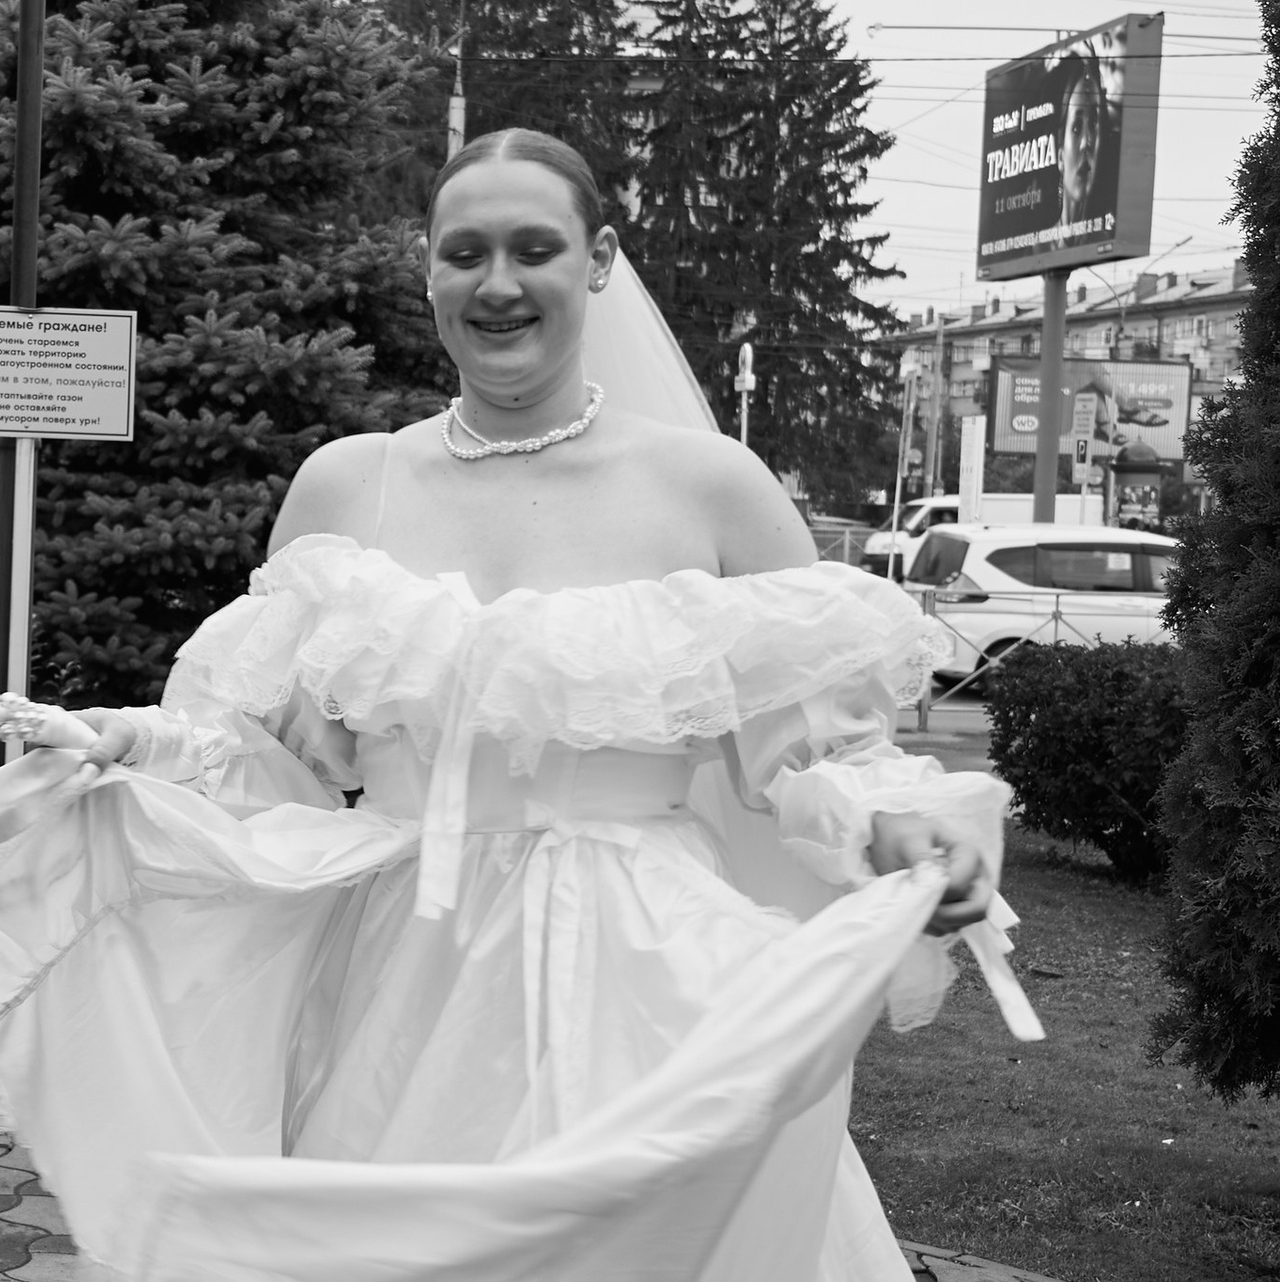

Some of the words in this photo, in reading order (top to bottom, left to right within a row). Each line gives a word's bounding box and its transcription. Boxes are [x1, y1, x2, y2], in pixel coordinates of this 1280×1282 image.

[987, 133, 1056, 183] ТРАВИАТА
[995, 198, 1004, 214] 11
[39, 322, 107, 333] граждане!
[27, 339, 79, 347] стараемся
[29, 350, 86, 359] территорию
[75, 363, 127, 371] состоянии.
[23, 377, 52, 385] этом,
[56, 378, 125, 389] пожалуйста!
[43, 417, 76, 425] поверх
[79, 417, 100, 426] урн!
